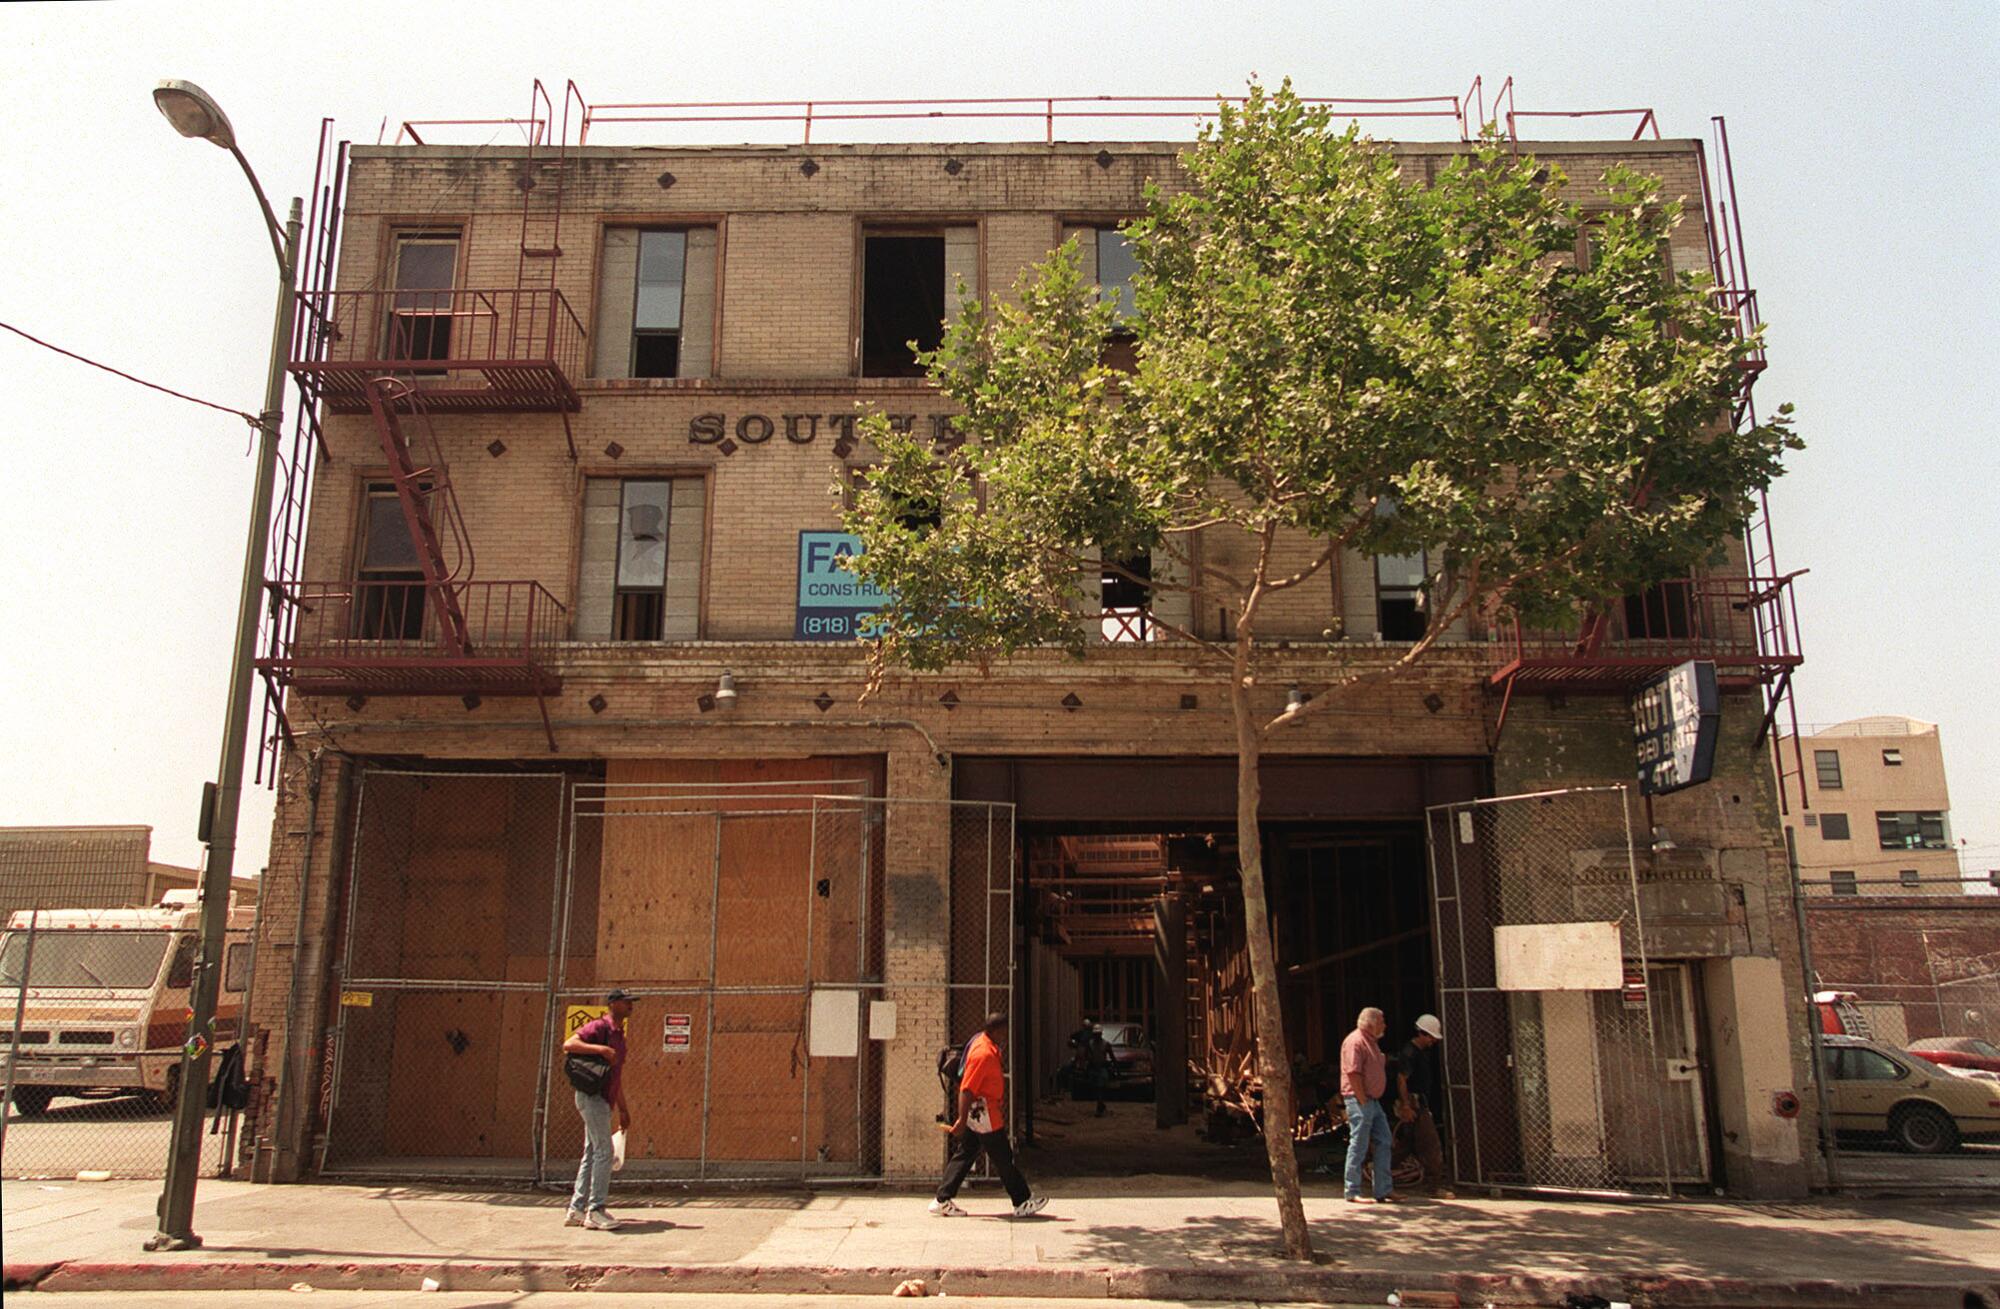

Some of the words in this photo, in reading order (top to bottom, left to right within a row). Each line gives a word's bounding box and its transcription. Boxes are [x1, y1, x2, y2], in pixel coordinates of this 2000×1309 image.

[688, 413, 994, 446] SOUTHE
[806, 541, 868, 574] FA
[808, 583, 897, 597] CONSTRU
[803, 616, 849, 635] (818)
[1632, 670, 1695, 736] HOTEL
